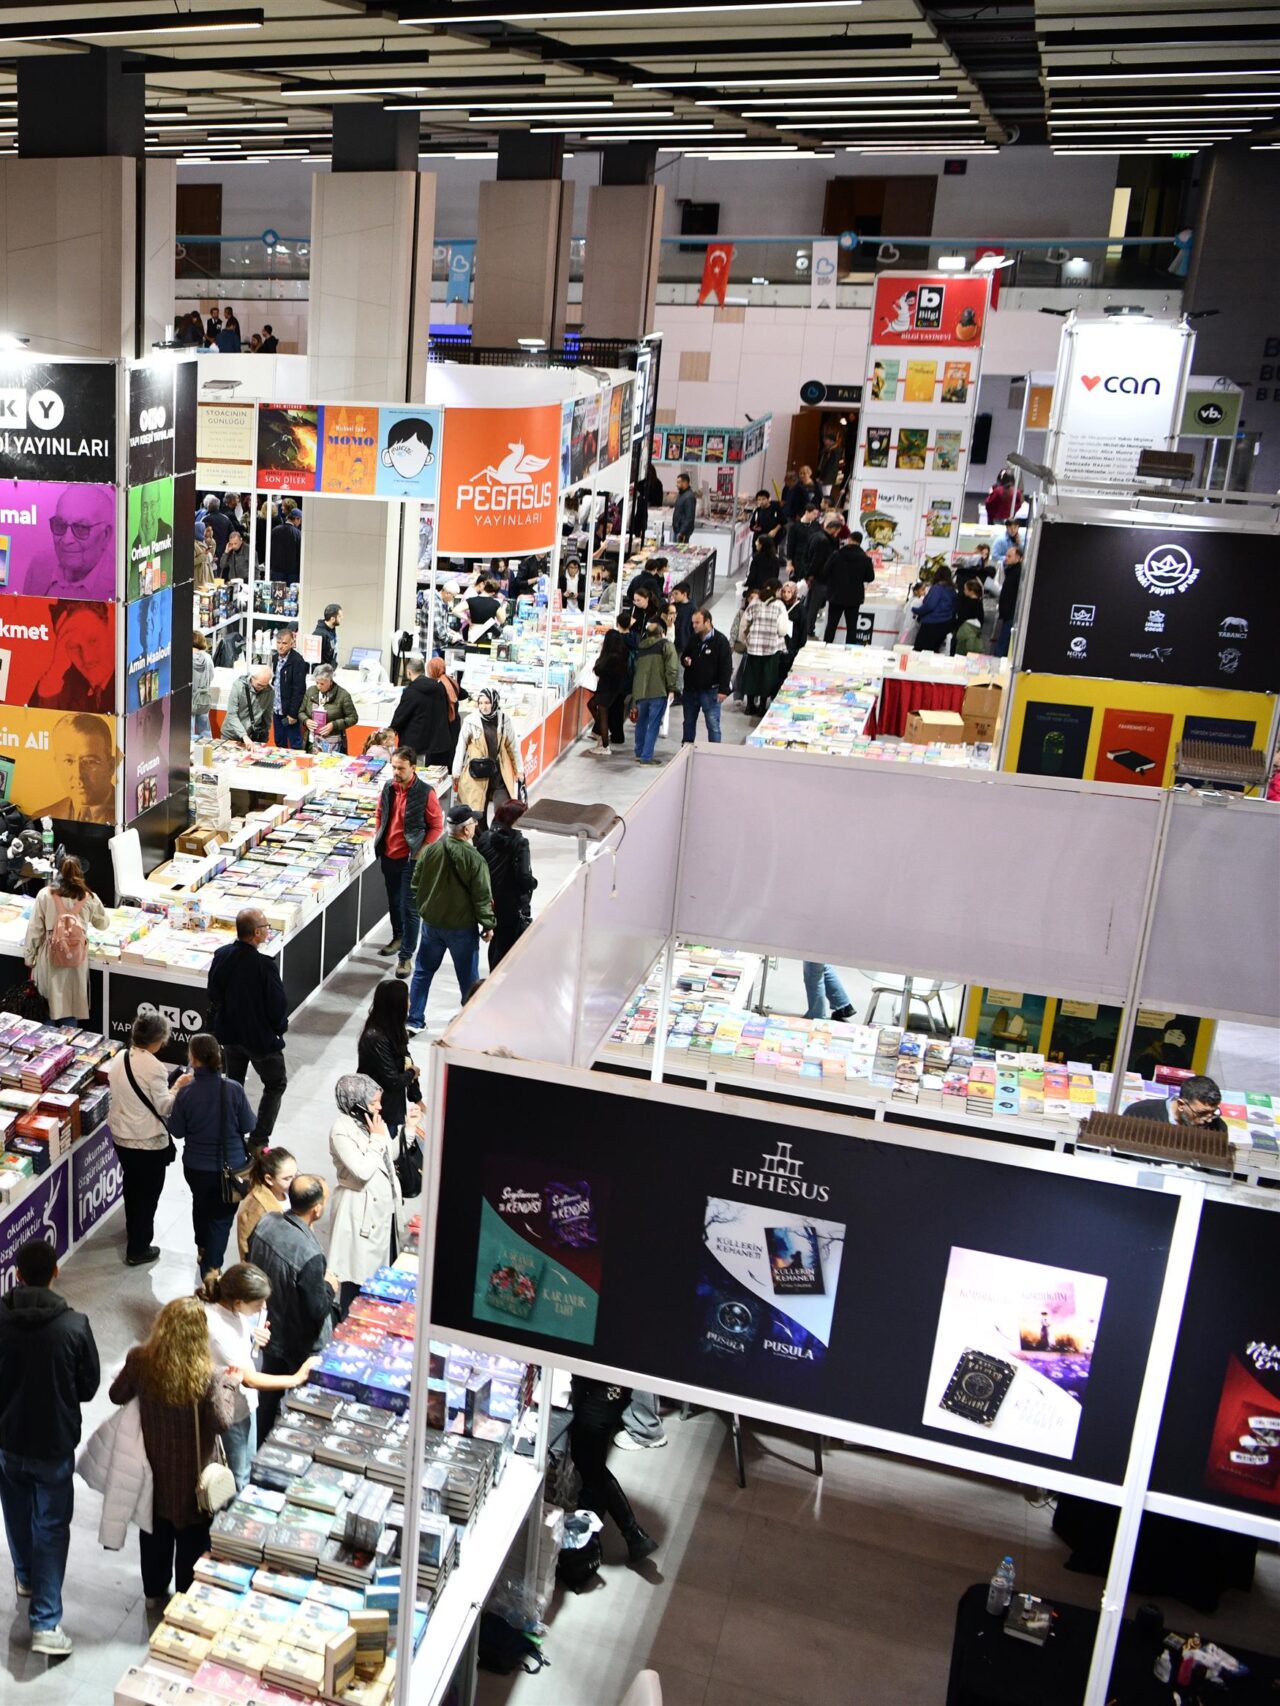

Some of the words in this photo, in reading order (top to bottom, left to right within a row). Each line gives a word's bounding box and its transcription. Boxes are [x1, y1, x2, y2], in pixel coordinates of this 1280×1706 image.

[1104, 375, 1161, 395] can
[1200, 403, 1222, 419] vb.
[13, 436, 110, 457] YAYINLARI
[328, 435, 375, 446] MOMO
[456, 482, 551, 511] PEGASUS
[474, 513, 542, 526] YAYINLARI
[131, 544, 150, 561] Orhan
[151, 535, 172, 554] Pamuk
[24, 730, 49, 750] Ali
[111, 1020, 132, 1032] YAP
[83, 1136, 111, 1166] okumak
[731, 1168, 831, 1203] EPHESUS
[7, 1206, 35, 1240] okumak
[706, 1331, 745, 1353] PUSULA
[764, 1339, 815, 1361] PUSULA
